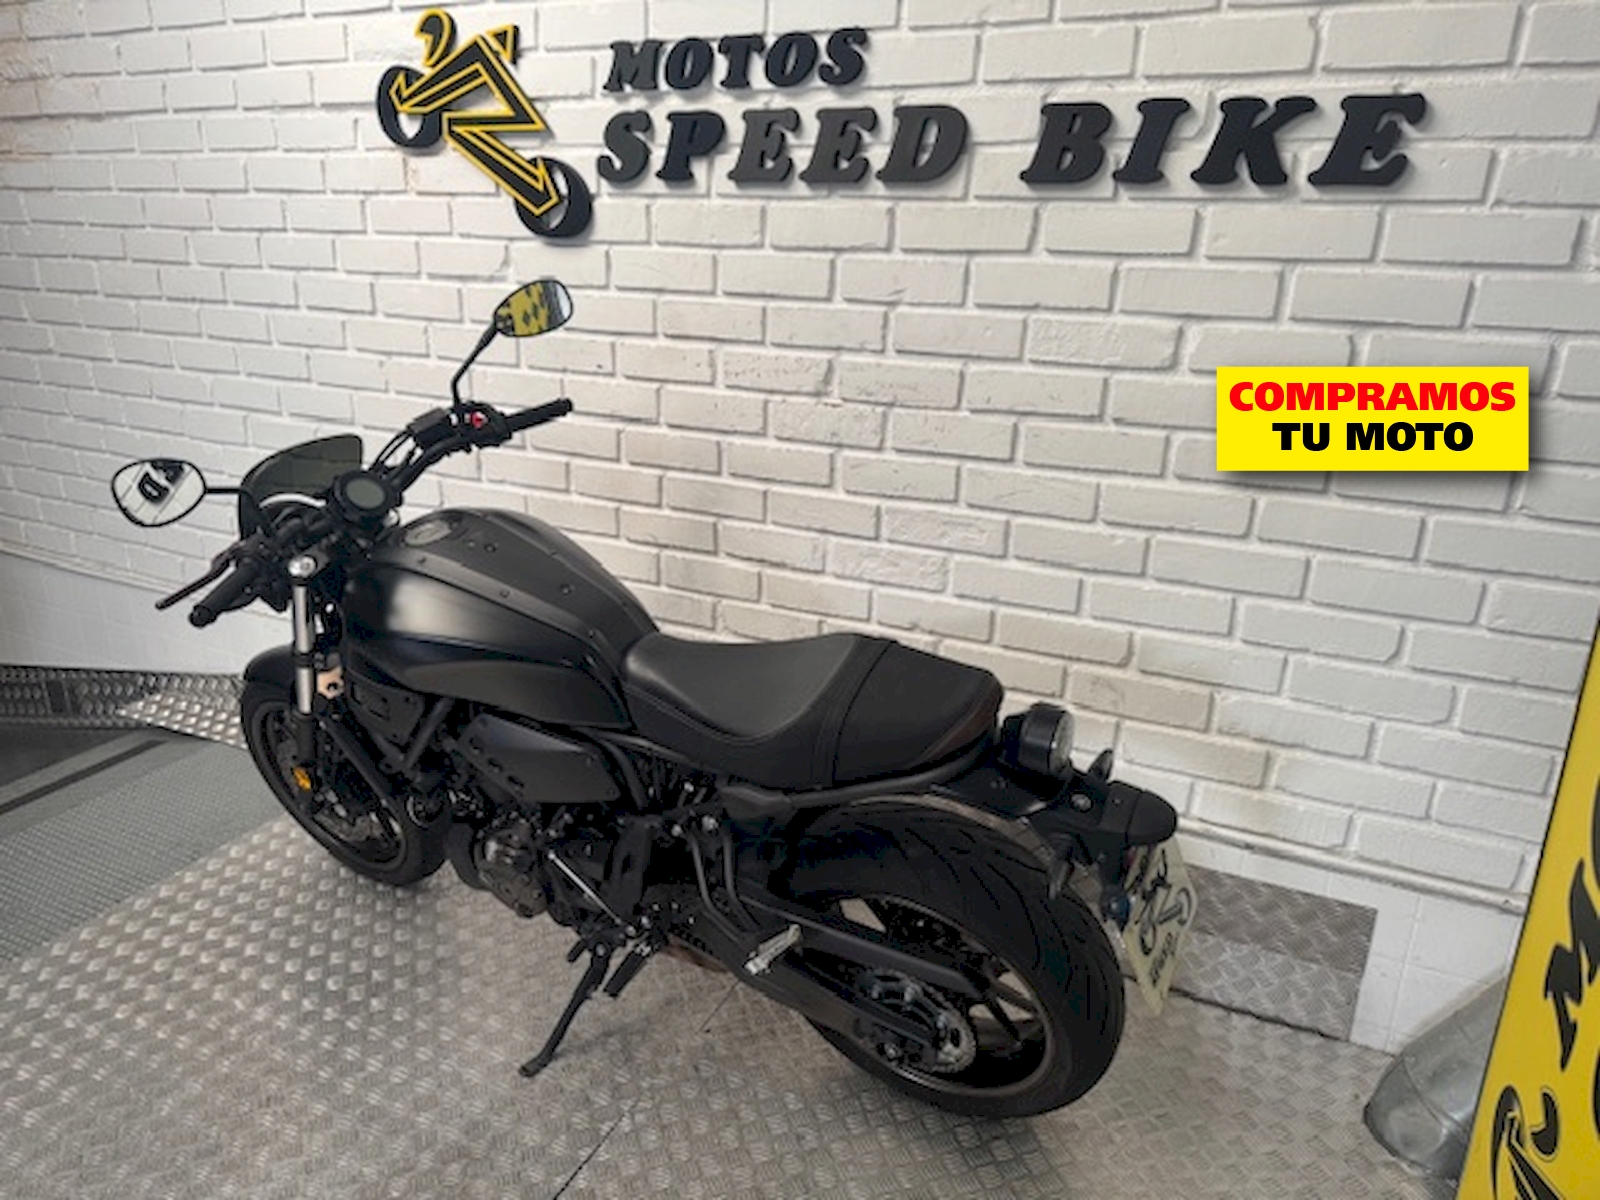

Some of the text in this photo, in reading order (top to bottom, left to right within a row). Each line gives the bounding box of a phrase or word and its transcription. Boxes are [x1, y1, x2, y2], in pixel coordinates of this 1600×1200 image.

[602, 28, 867, 92] MOTOS
[597, 93, 1427, 188] SPEED BIKE
